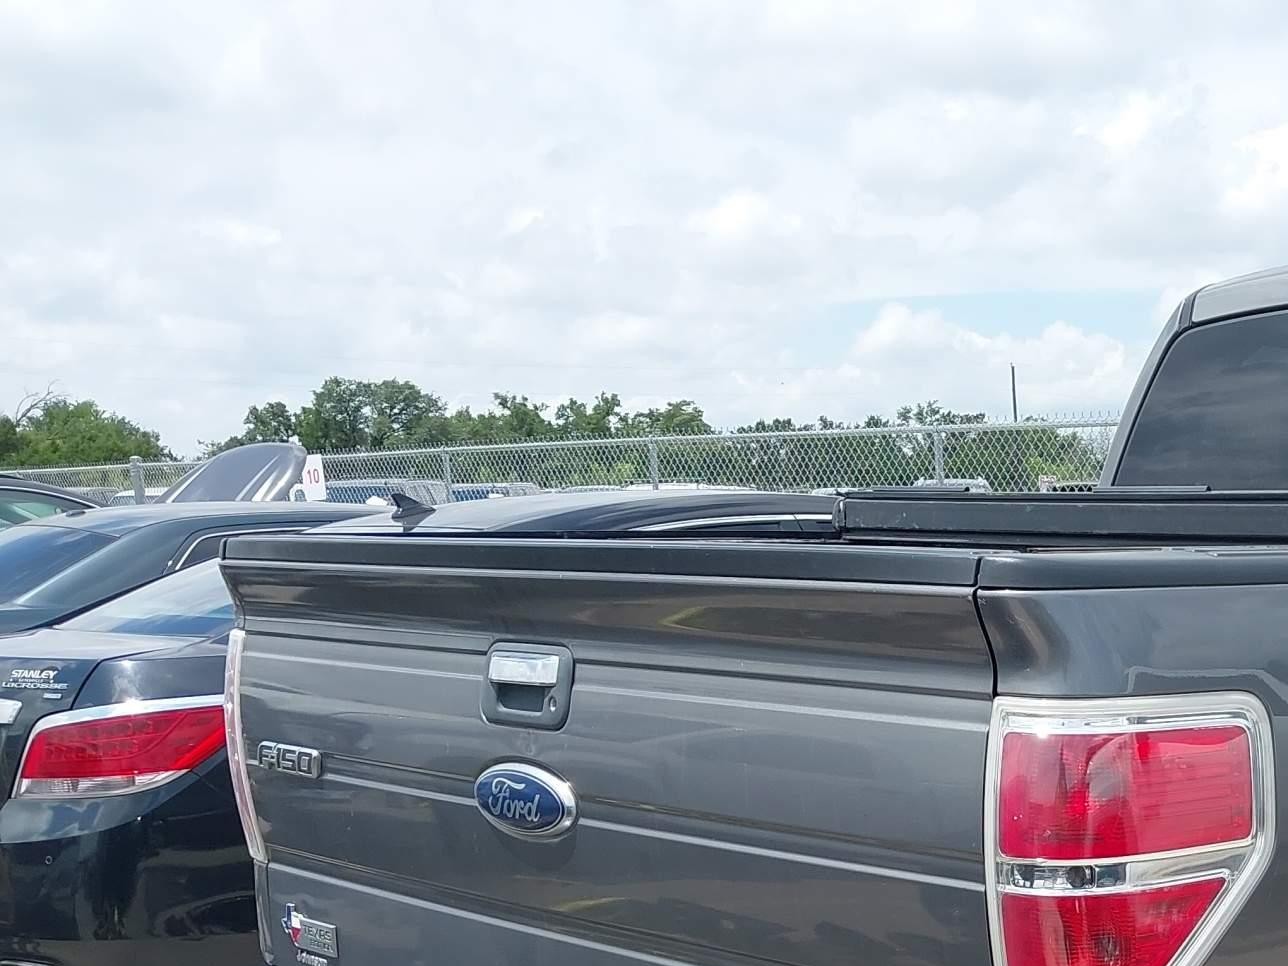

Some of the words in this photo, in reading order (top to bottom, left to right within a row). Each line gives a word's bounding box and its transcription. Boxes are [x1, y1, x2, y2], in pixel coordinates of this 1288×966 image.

[307, 468, 320, 484] 10
[10, 669, 59, 679] STANLEY
[488, 777, 541, 822] Ford
